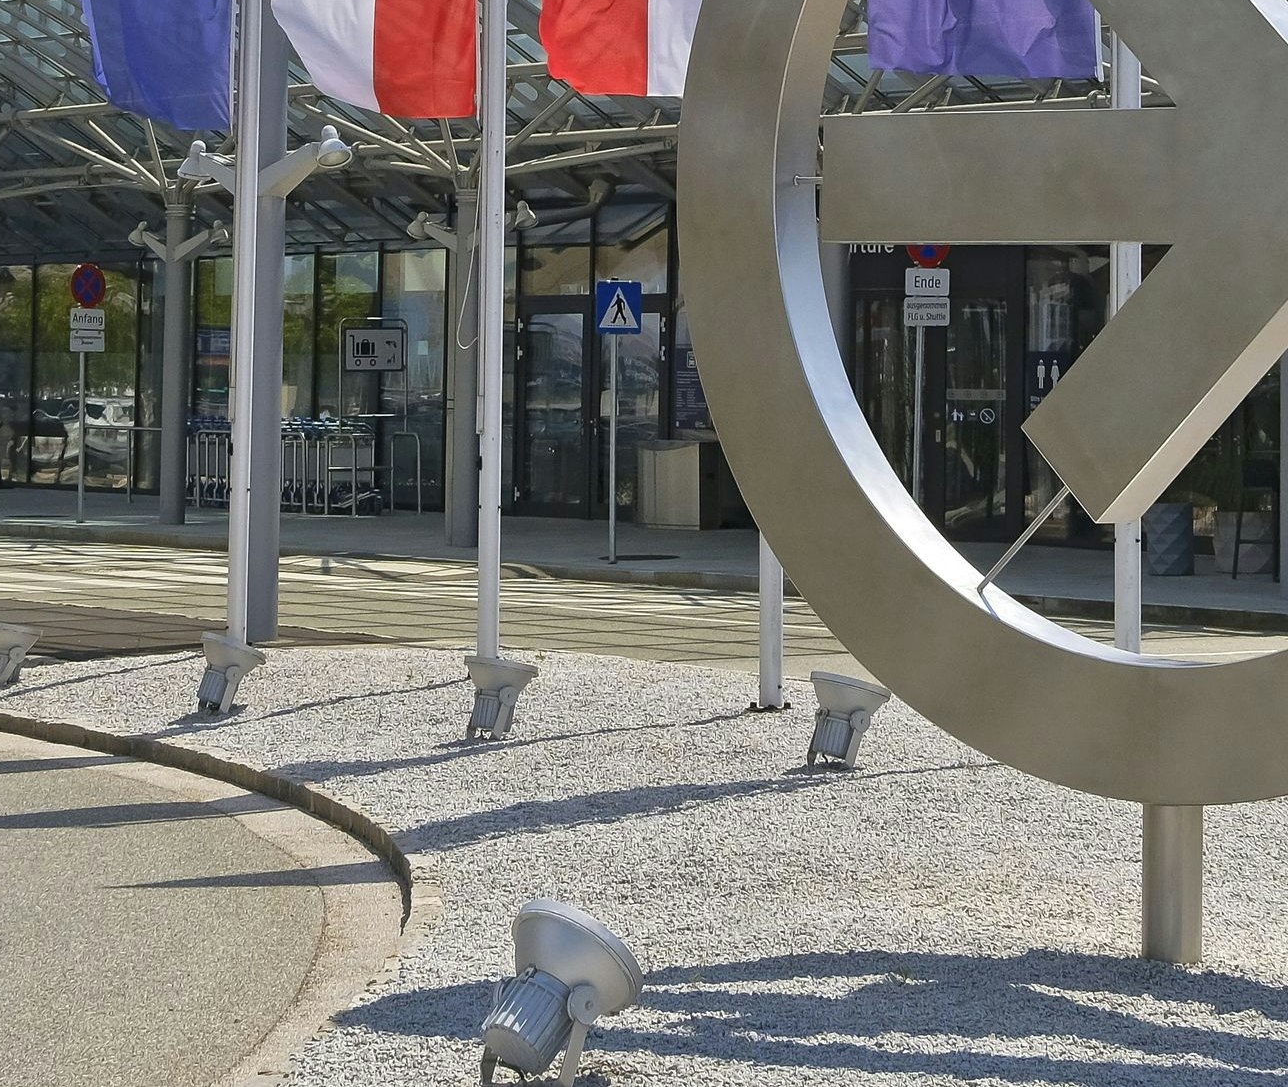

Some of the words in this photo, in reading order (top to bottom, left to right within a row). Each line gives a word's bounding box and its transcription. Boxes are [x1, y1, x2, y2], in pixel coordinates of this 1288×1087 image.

[914, 275, 941, 289] Ende
[72, 313, 103, 325] Anfang
[907, 312, 918, 321] FLG
[926, 312, 947, 321] Shuttle
